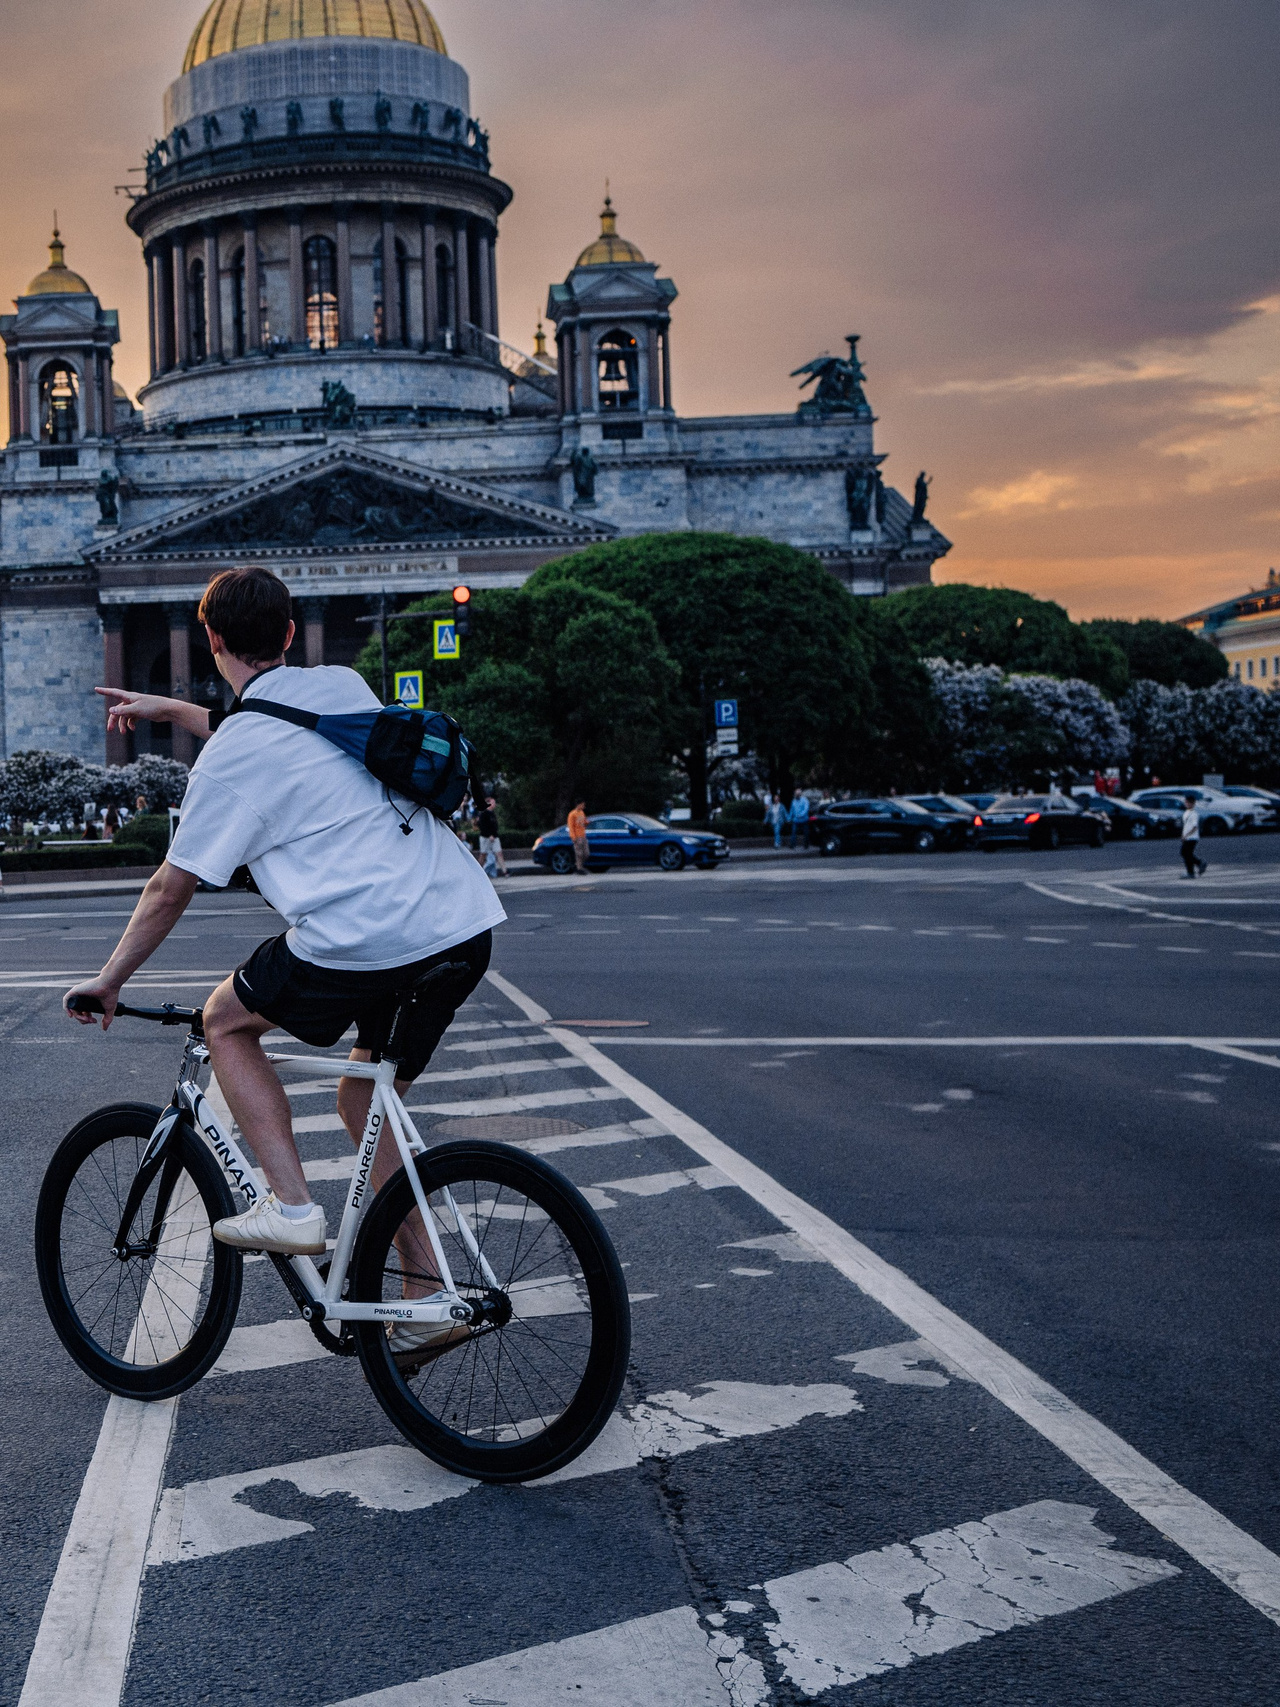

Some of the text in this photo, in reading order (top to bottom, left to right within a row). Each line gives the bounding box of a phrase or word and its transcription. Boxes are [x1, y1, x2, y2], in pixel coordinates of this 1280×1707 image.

[721, 703, 733, 722] P
[204, 1124, 258, 1206] PINAR
[351, 1113, 381, 1209] PINARELLO
[374, 1308, 413, 1316] PINARELLO
